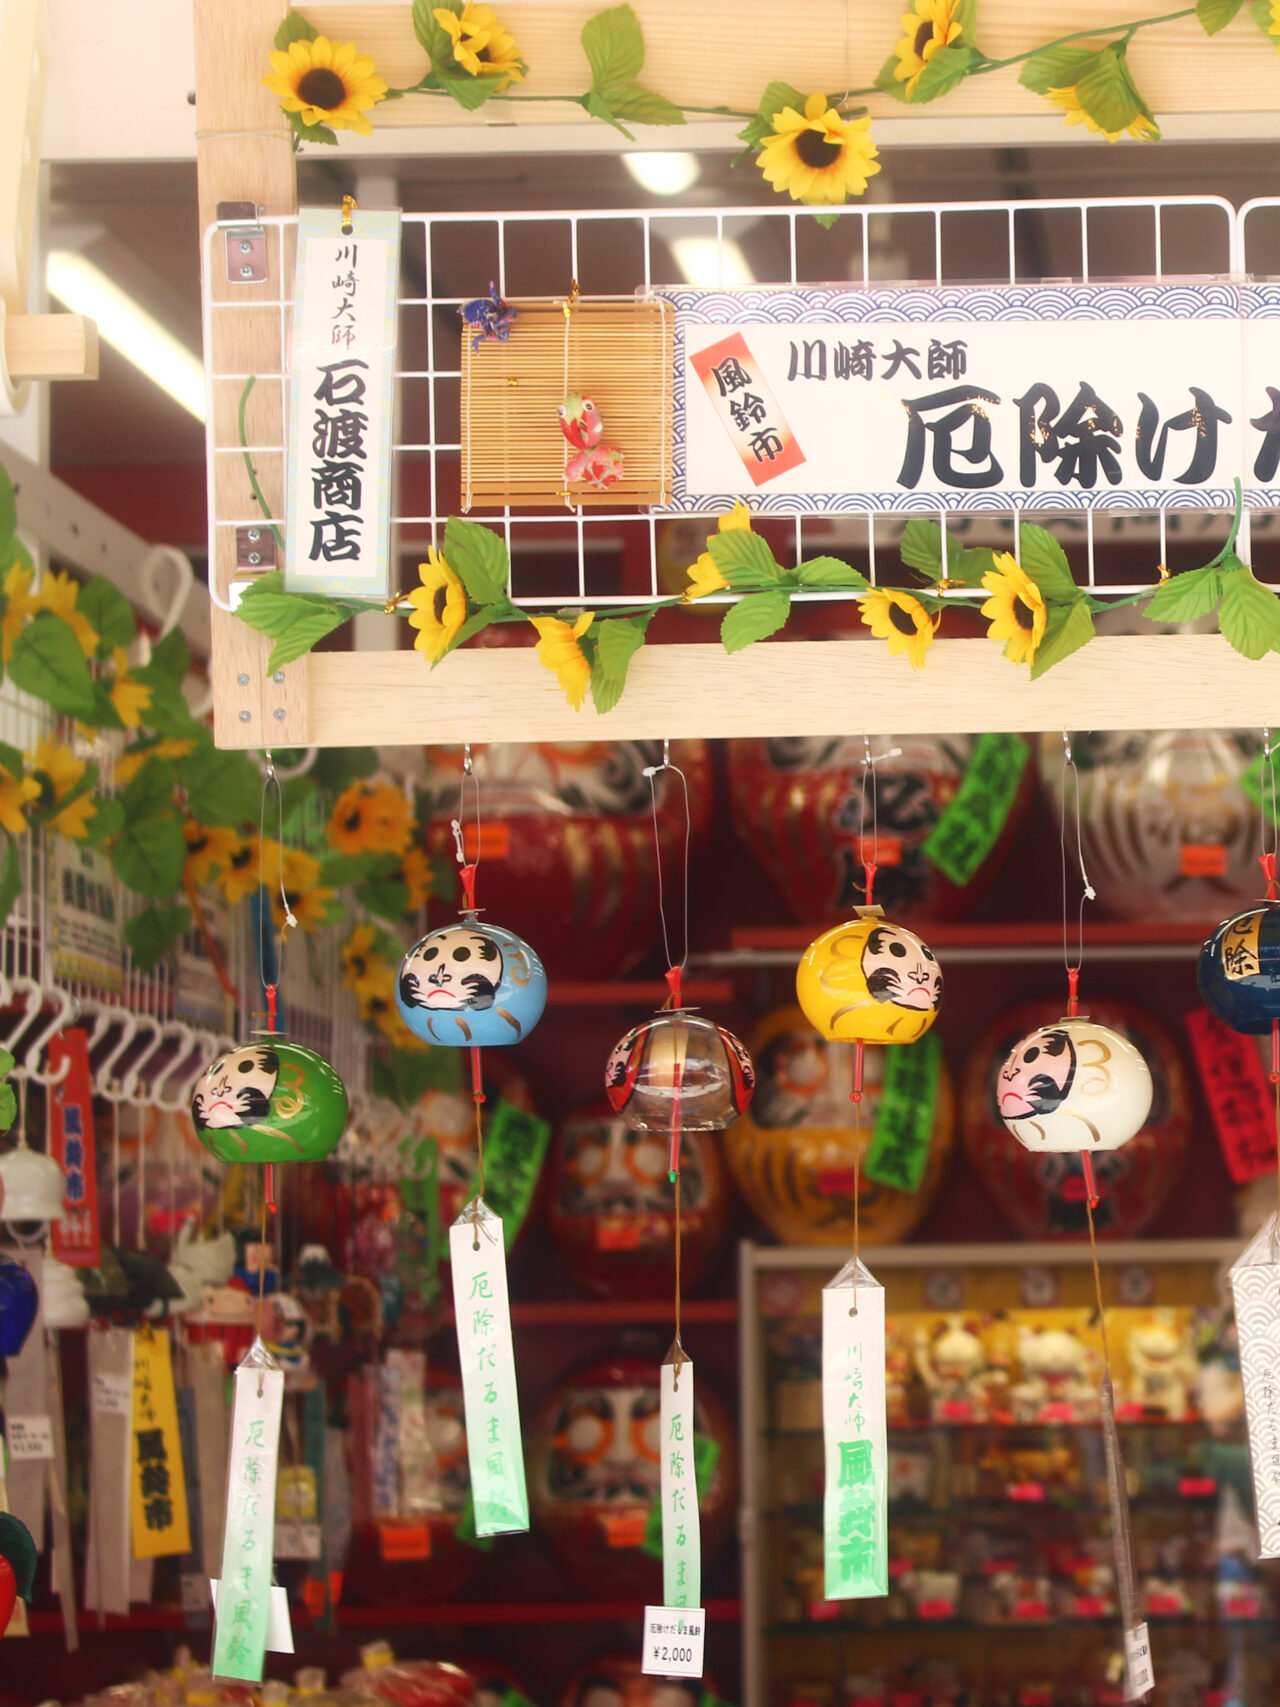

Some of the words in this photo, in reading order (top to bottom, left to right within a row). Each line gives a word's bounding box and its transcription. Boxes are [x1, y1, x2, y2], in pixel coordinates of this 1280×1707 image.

[331, 244, 360, 349] 川崎大師
[710, 356, 783, 463] 風鈴市
[787, 339, 967, 381] 川崎大師
[309, 358, 370, 562] 石渡商店
[653, 1646, 693, 1663] ¥2,000
